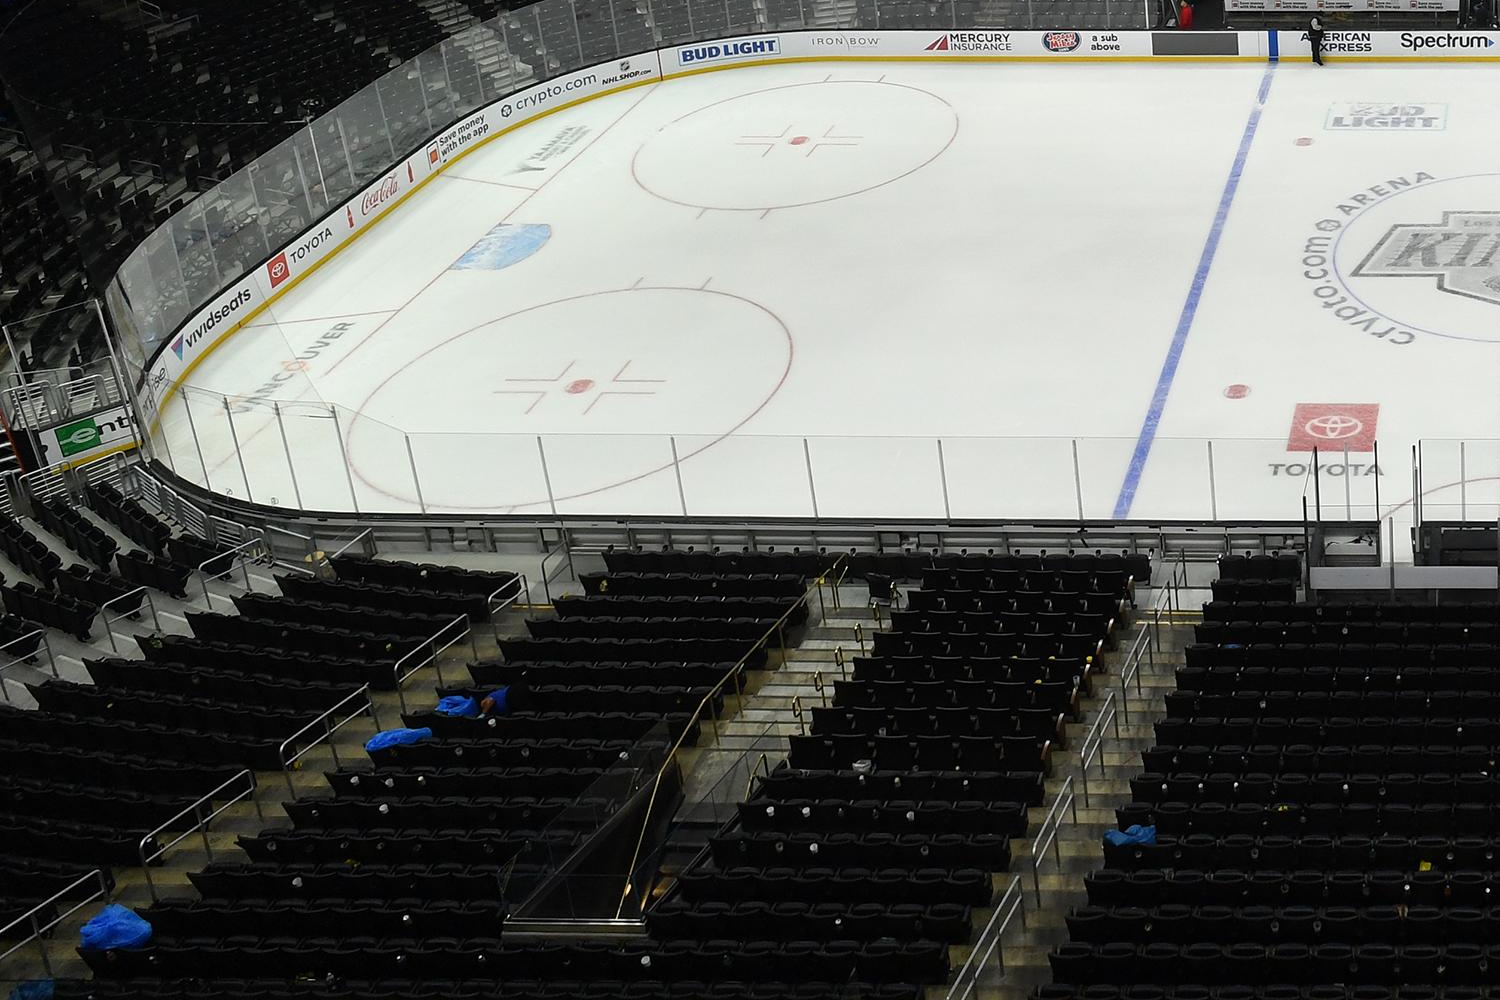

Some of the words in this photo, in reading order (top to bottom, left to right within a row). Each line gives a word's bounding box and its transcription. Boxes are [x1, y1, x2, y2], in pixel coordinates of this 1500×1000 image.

[811, 37, 843, 46] IRON
[849, 38, 880, 46] BOW
[949, 33, 1010, 43] MERCURY
[1048, 32, 1076, 41] Jersey
[1101, 34, 1118, 42] sub
[1300, 33, 1370, 41] AERICAN
[1401, 32, 1488, 51] Spectrum
[682, 46, 720, 63] BUD
[724, 40, 776, 56] LIGHT
[949, 43, 1012, 51] INSURANCE
[1091, 43, 1120, 51] above
[1320, 43, 1372, 51] XPRESS
[602, 69, 651, 85] NHLSHOP.COM
[516, 72, 597, 111] crypto.com
[1332, 116, 1440, 128] LIGHT
[439, 127, 457, 146] Save
[457, 114, 486, 138] money
[440, 140, 458, 157] with
[459, 132, 472, 146] the
[473, 122, 489, 140] app
[1336, 171, 1435, 217] ARENA
[290, 227, 332, 263] TOYOTA
[1302, 235, 1416, 345] crypto.com
[185, 287, 251, 348] vividseats
[1268, 463, 1384, 477] TOYOTA
